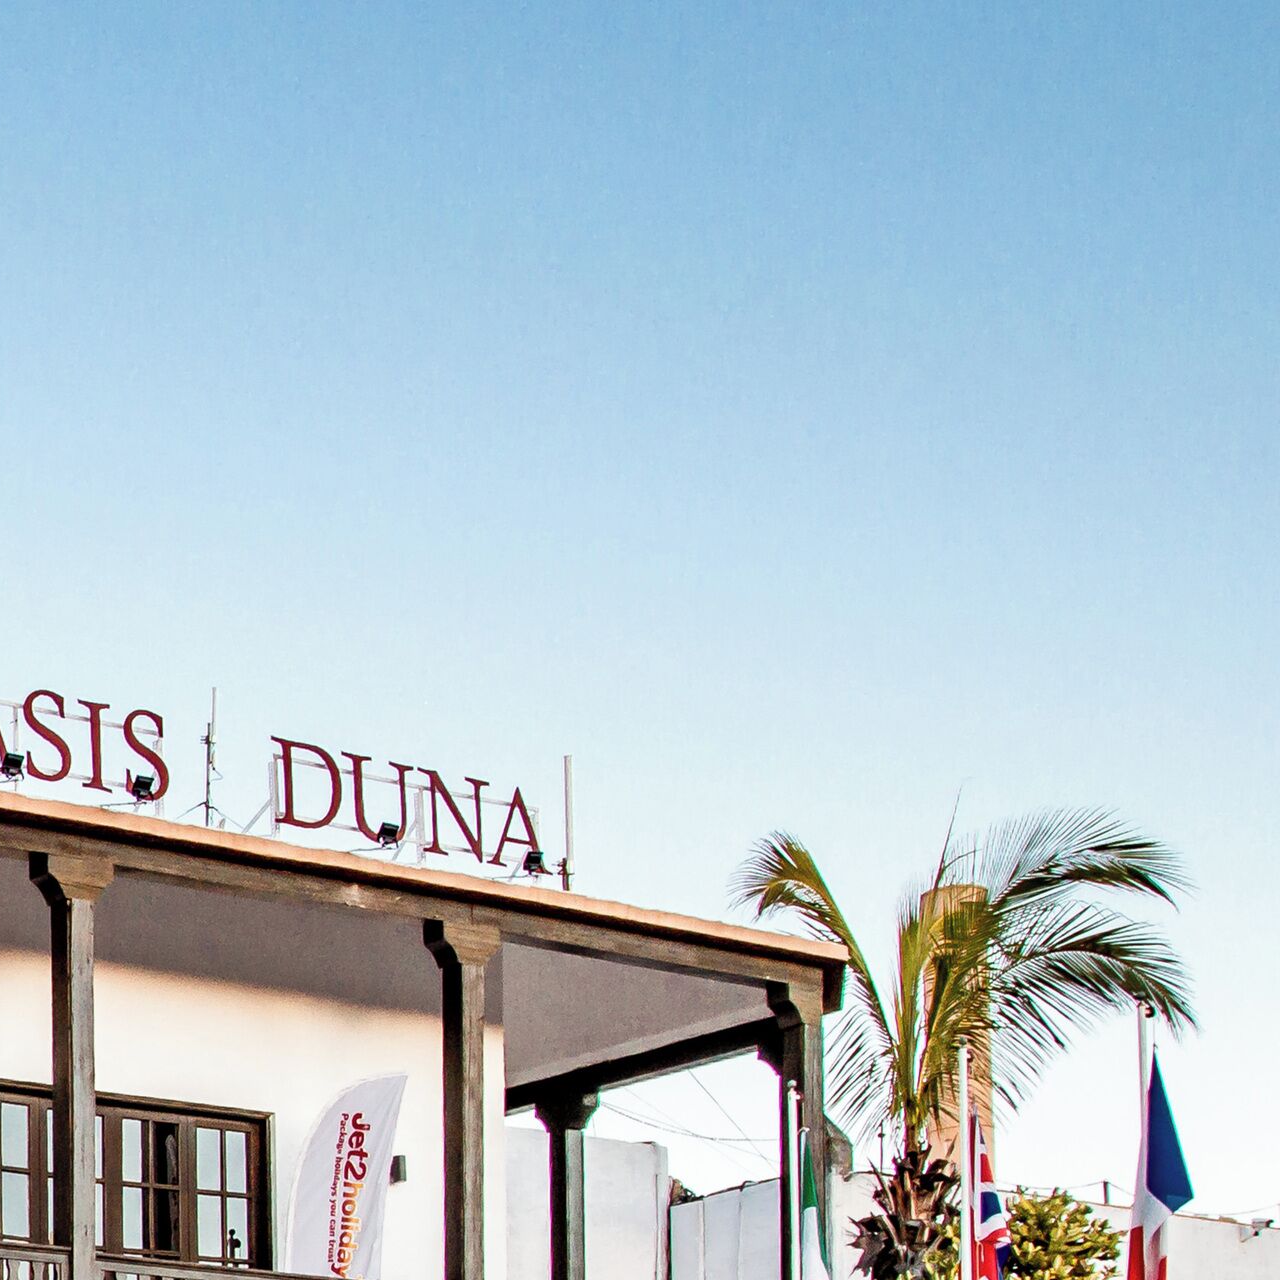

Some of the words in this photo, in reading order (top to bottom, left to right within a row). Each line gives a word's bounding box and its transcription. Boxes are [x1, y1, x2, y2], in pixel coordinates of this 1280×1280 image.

[270, 735, 553, 876] DUNA
[336, 1112, 350, 1155] Package
[330, 1156, 344, 1197] holidays
[329, 1199, 337, 1217] you
[327, 1239, 336, 1263] trust
